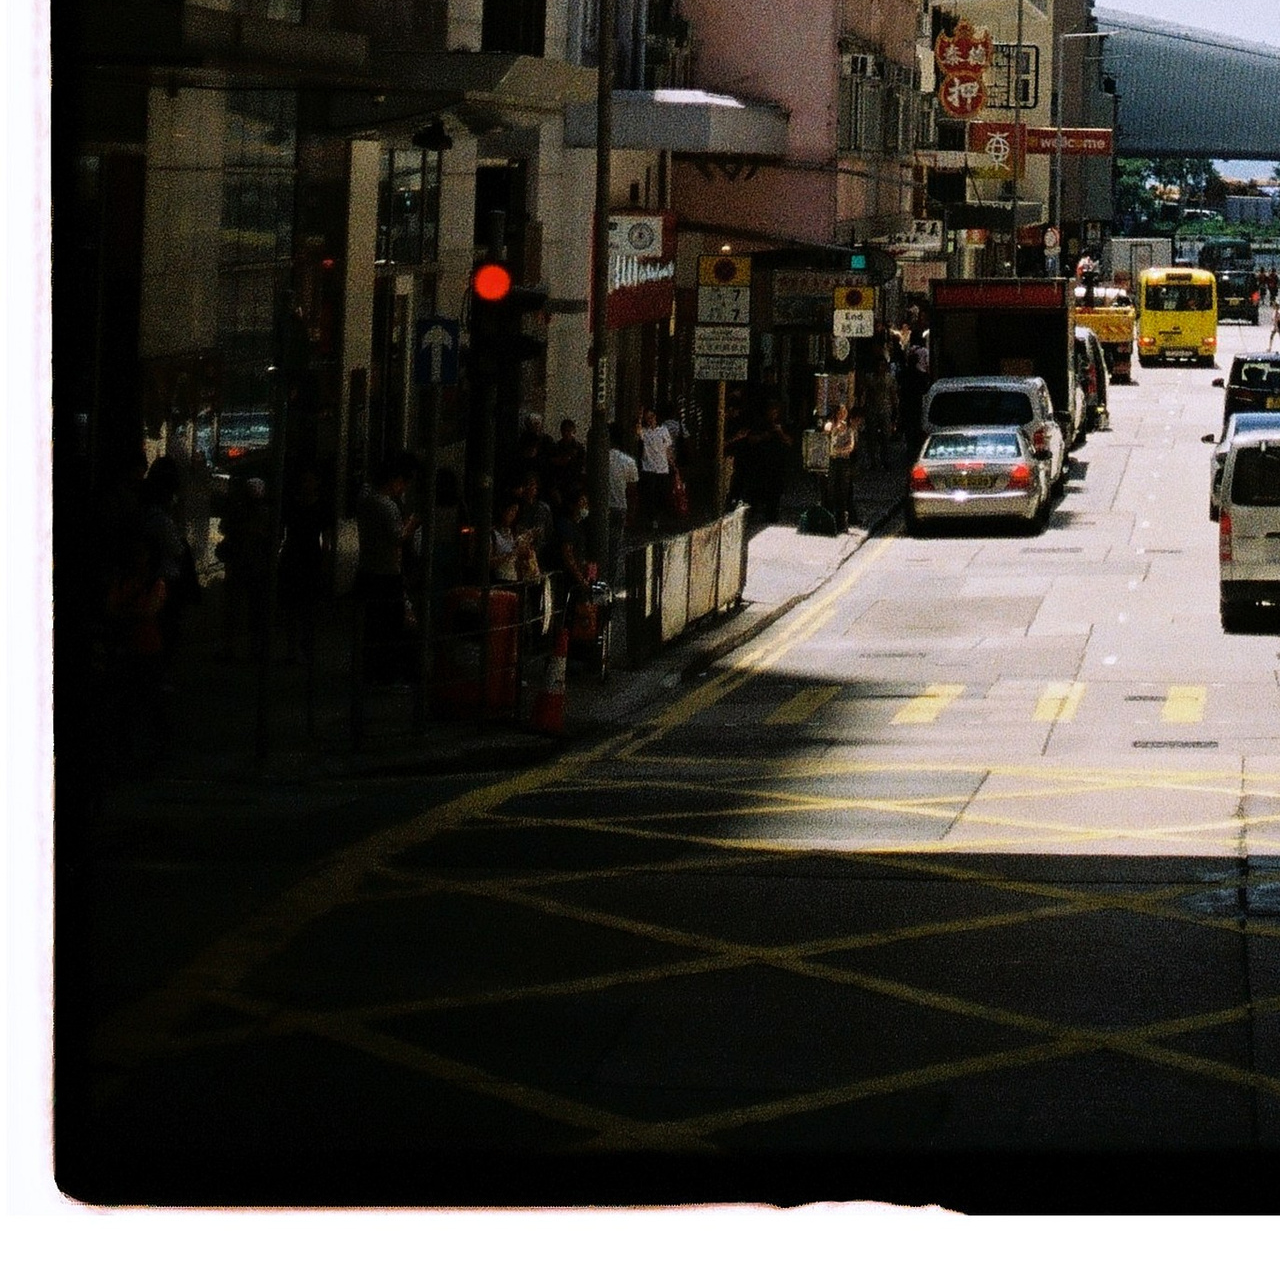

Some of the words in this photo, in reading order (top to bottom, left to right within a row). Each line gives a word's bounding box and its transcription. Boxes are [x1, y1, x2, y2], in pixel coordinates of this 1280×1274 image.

[947, 77, 979, 111] 押
[733, 289, 741, 302] 7
[732, 309, 740, 321] 7
[845, 312, 864, 321] End
